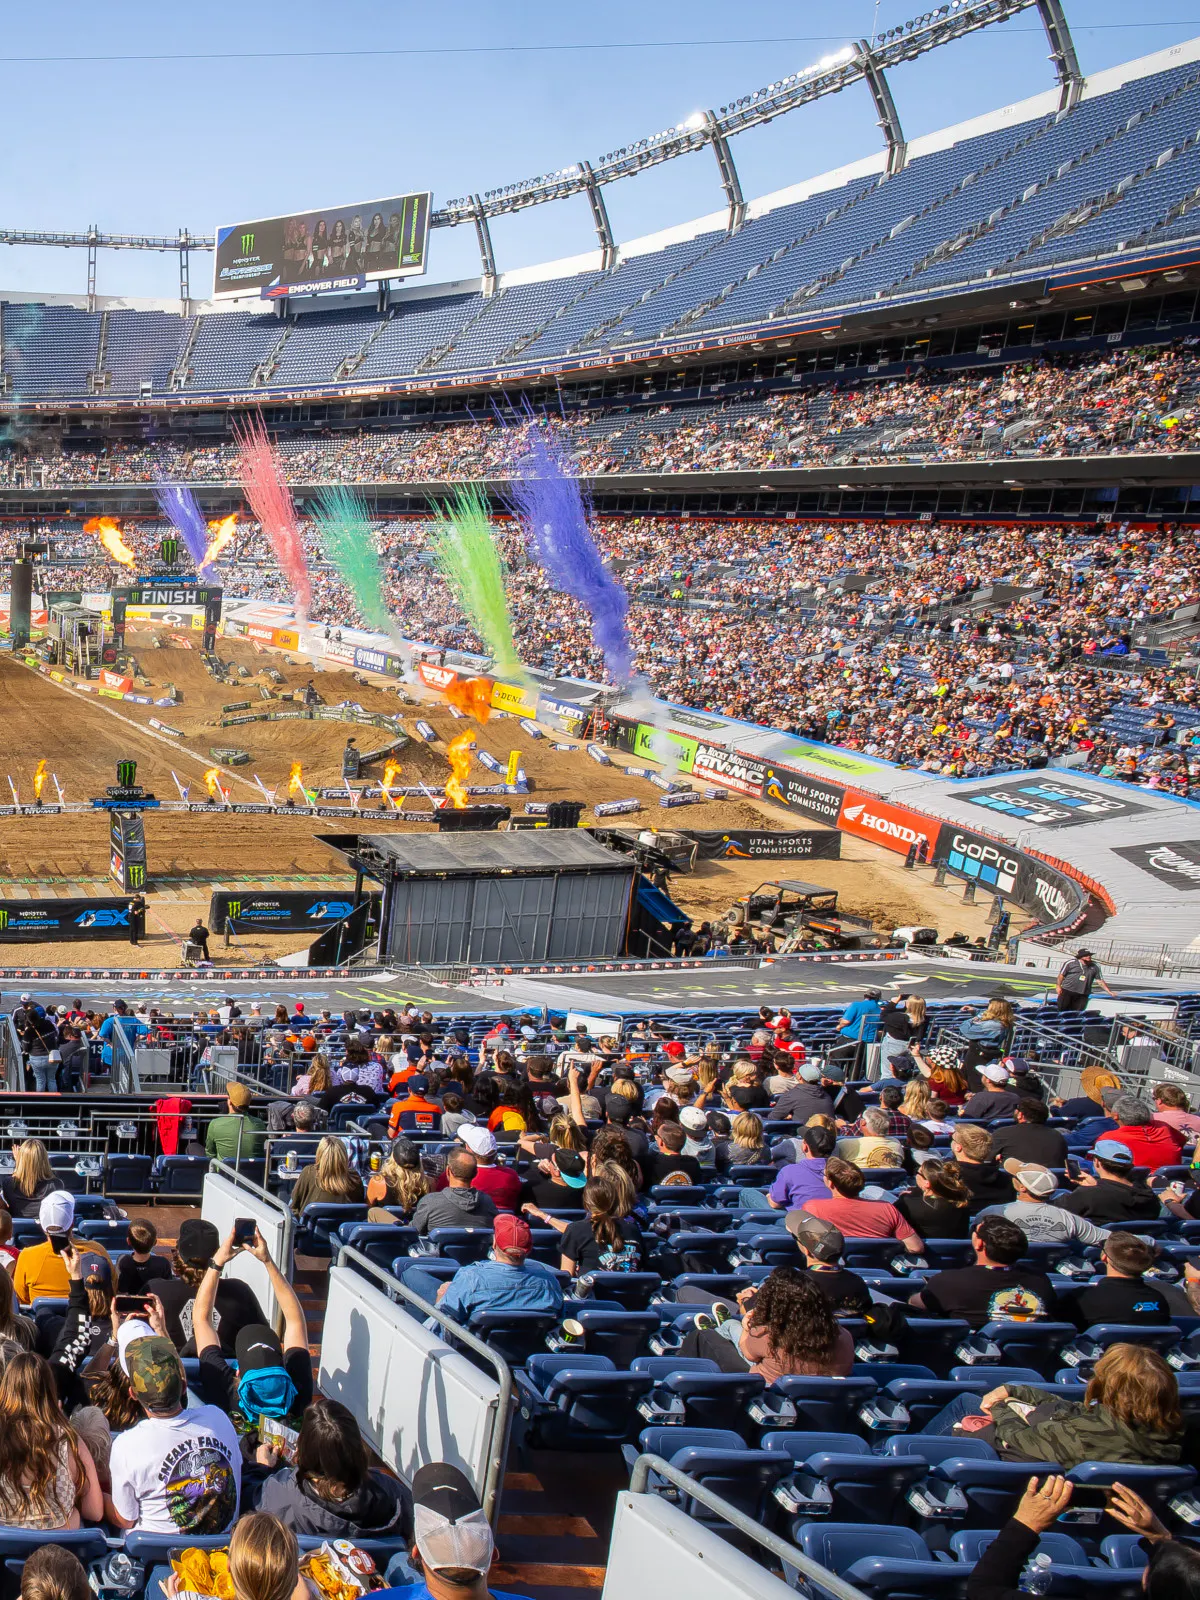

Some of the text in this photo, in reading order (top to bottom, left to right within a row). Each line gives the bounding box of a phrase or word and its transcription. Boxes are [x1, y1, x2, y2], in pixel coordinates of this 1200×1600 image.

[232, 256, 260, 264] MONSTER
[288, 277, 358, 294] EMPOWER FIELD
[141, 591, 197, 604] FINISH
[362, 650, 385, 667] YAMAHA
[707, 747, 766, 773] ROCKY MOUNTAIN
[93, 800, 161, 808] SUPERCROSS
[789, 781, 841, 806] UTAH SPORTS
[1038, 783, 1126, 809] GoPro
[787, 792, 839, 817] COMMISSION
[989, 792, 1072, 819] GoPro
[861, 812, 929, 846] HONDA
[749, 846, 812, 854] COMMISSION
[750, 838, 776, 846] UTAH
[953, 835, 1019, 875] GoPro
[90, 1044, 103, 1055] 13
[158, 1439, 192, 1483] SNEAKY
[198, 1436, 233, 1459] FARMS
